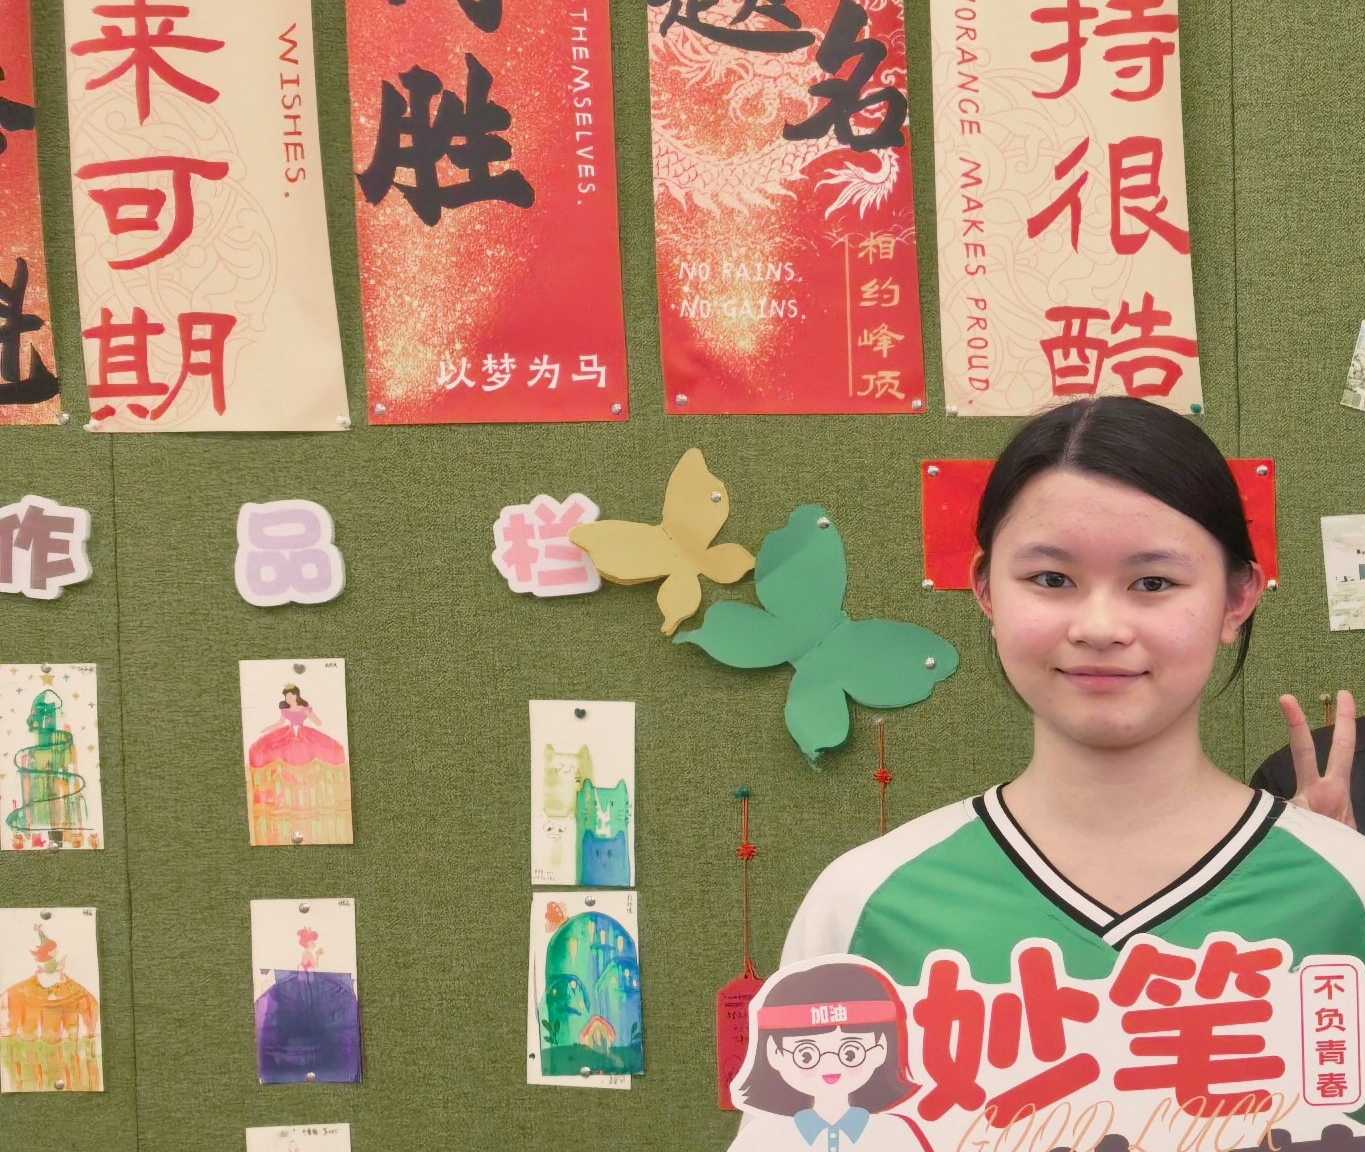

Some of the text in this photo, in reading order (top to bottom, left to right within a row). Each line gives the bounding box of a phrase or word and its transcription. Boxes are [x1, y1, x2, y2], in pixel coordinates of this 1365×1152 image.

[277, 22, 308, 199] WISHES.
[355, 0, 536, 227] 胜
[568, 8, 598, 206] THEMSELVES.
[70, 0, 237, 419] 来可期
[677, 260, 714, 284] NO
[953, 0, 990, 406] ORANCE MAKES PROUD.
[1027, 0, 1200, 397] 持很酷
[436, 354, 608, 390] 以梦为马
[678, 296, 807, 321] NO GAINS.
[858, 232, 905, 400] 相约峰顶
[810, 1004, 848, 1025] 加油
[913, 939, 1288, 1129] 妙笔
[1313, 974, 1348, 1100] 不负青春
